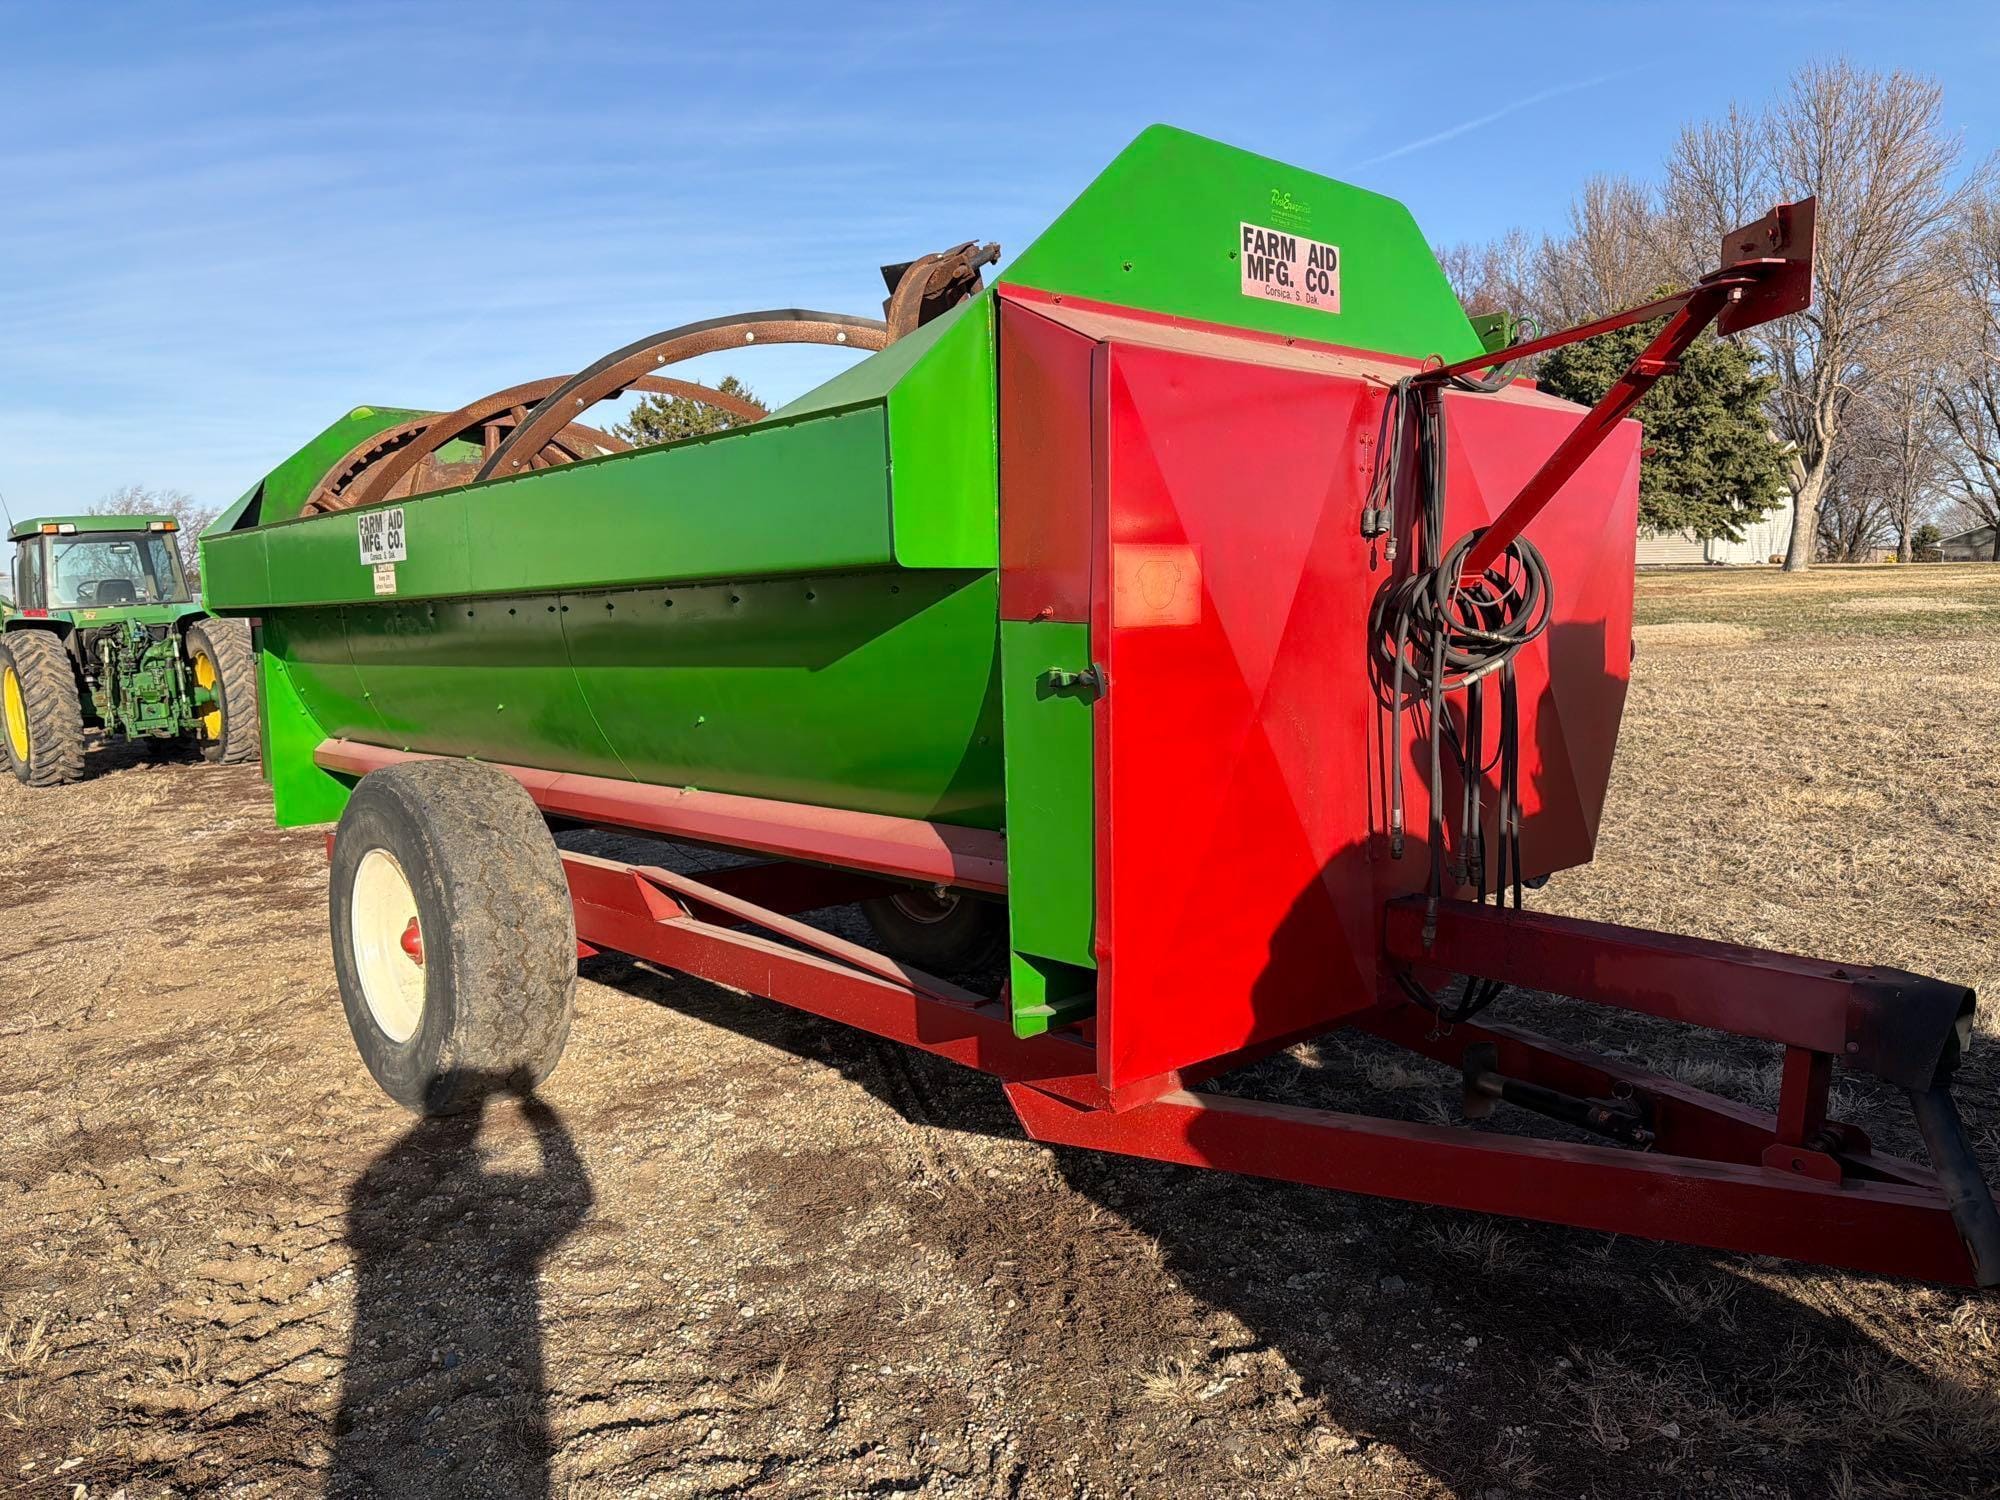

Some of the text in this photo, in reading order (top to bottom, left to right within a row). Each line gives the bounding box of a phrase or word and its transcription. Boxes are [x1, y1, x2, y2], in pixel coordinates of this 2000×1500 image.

[1243, 226, 1337, 271] FARM AID
[1247, 254, 1334, 296] MFG. CO.
[1305, 292, 1320, 305] Dak.
[359, 510, 403, 536] FARM AID
[362, 530, 403, 553] MFG. CO.
